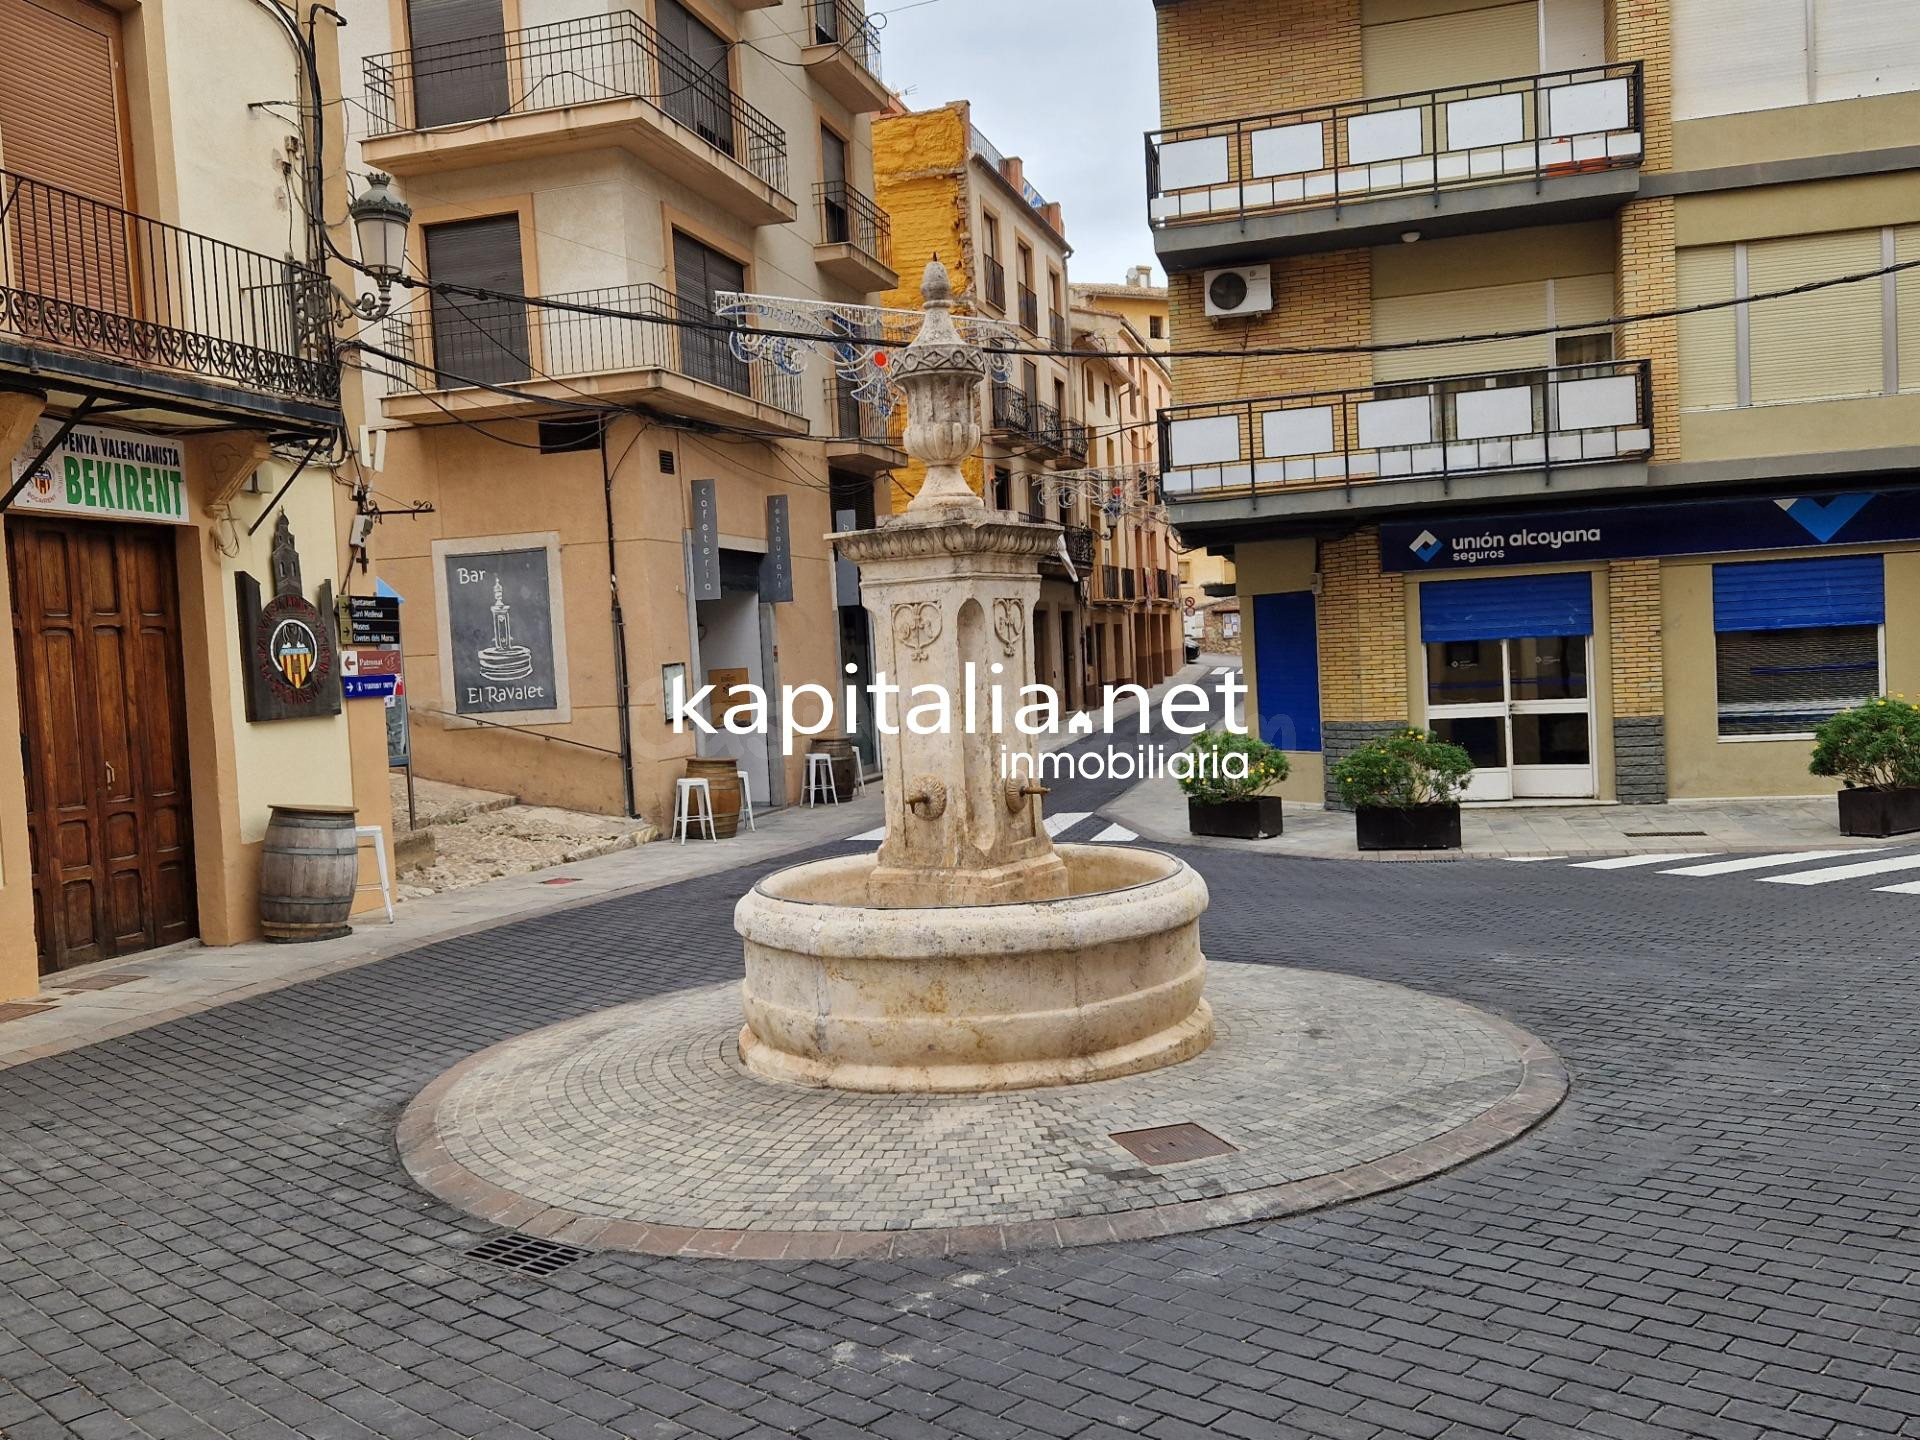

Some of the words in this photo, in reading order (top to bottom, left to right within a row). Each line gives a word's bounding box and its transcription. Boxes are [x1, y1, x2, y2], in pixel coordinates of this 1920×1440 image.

[62, 433, 98, 456] PENYA
[100, 437, 181, 468] VALENCIANISTA
[63, 455, 183, 516] BEKIRENT
[1452, 531, 1505, 550] unión
[1509, 528, 1601, 549] alcoyana
[1452, 549, 1505, 563] seguros
[456, 567, 486, 585] Bar
[467, 687, 483, 704] El
[485, 685, 545, 703] Ravalet
